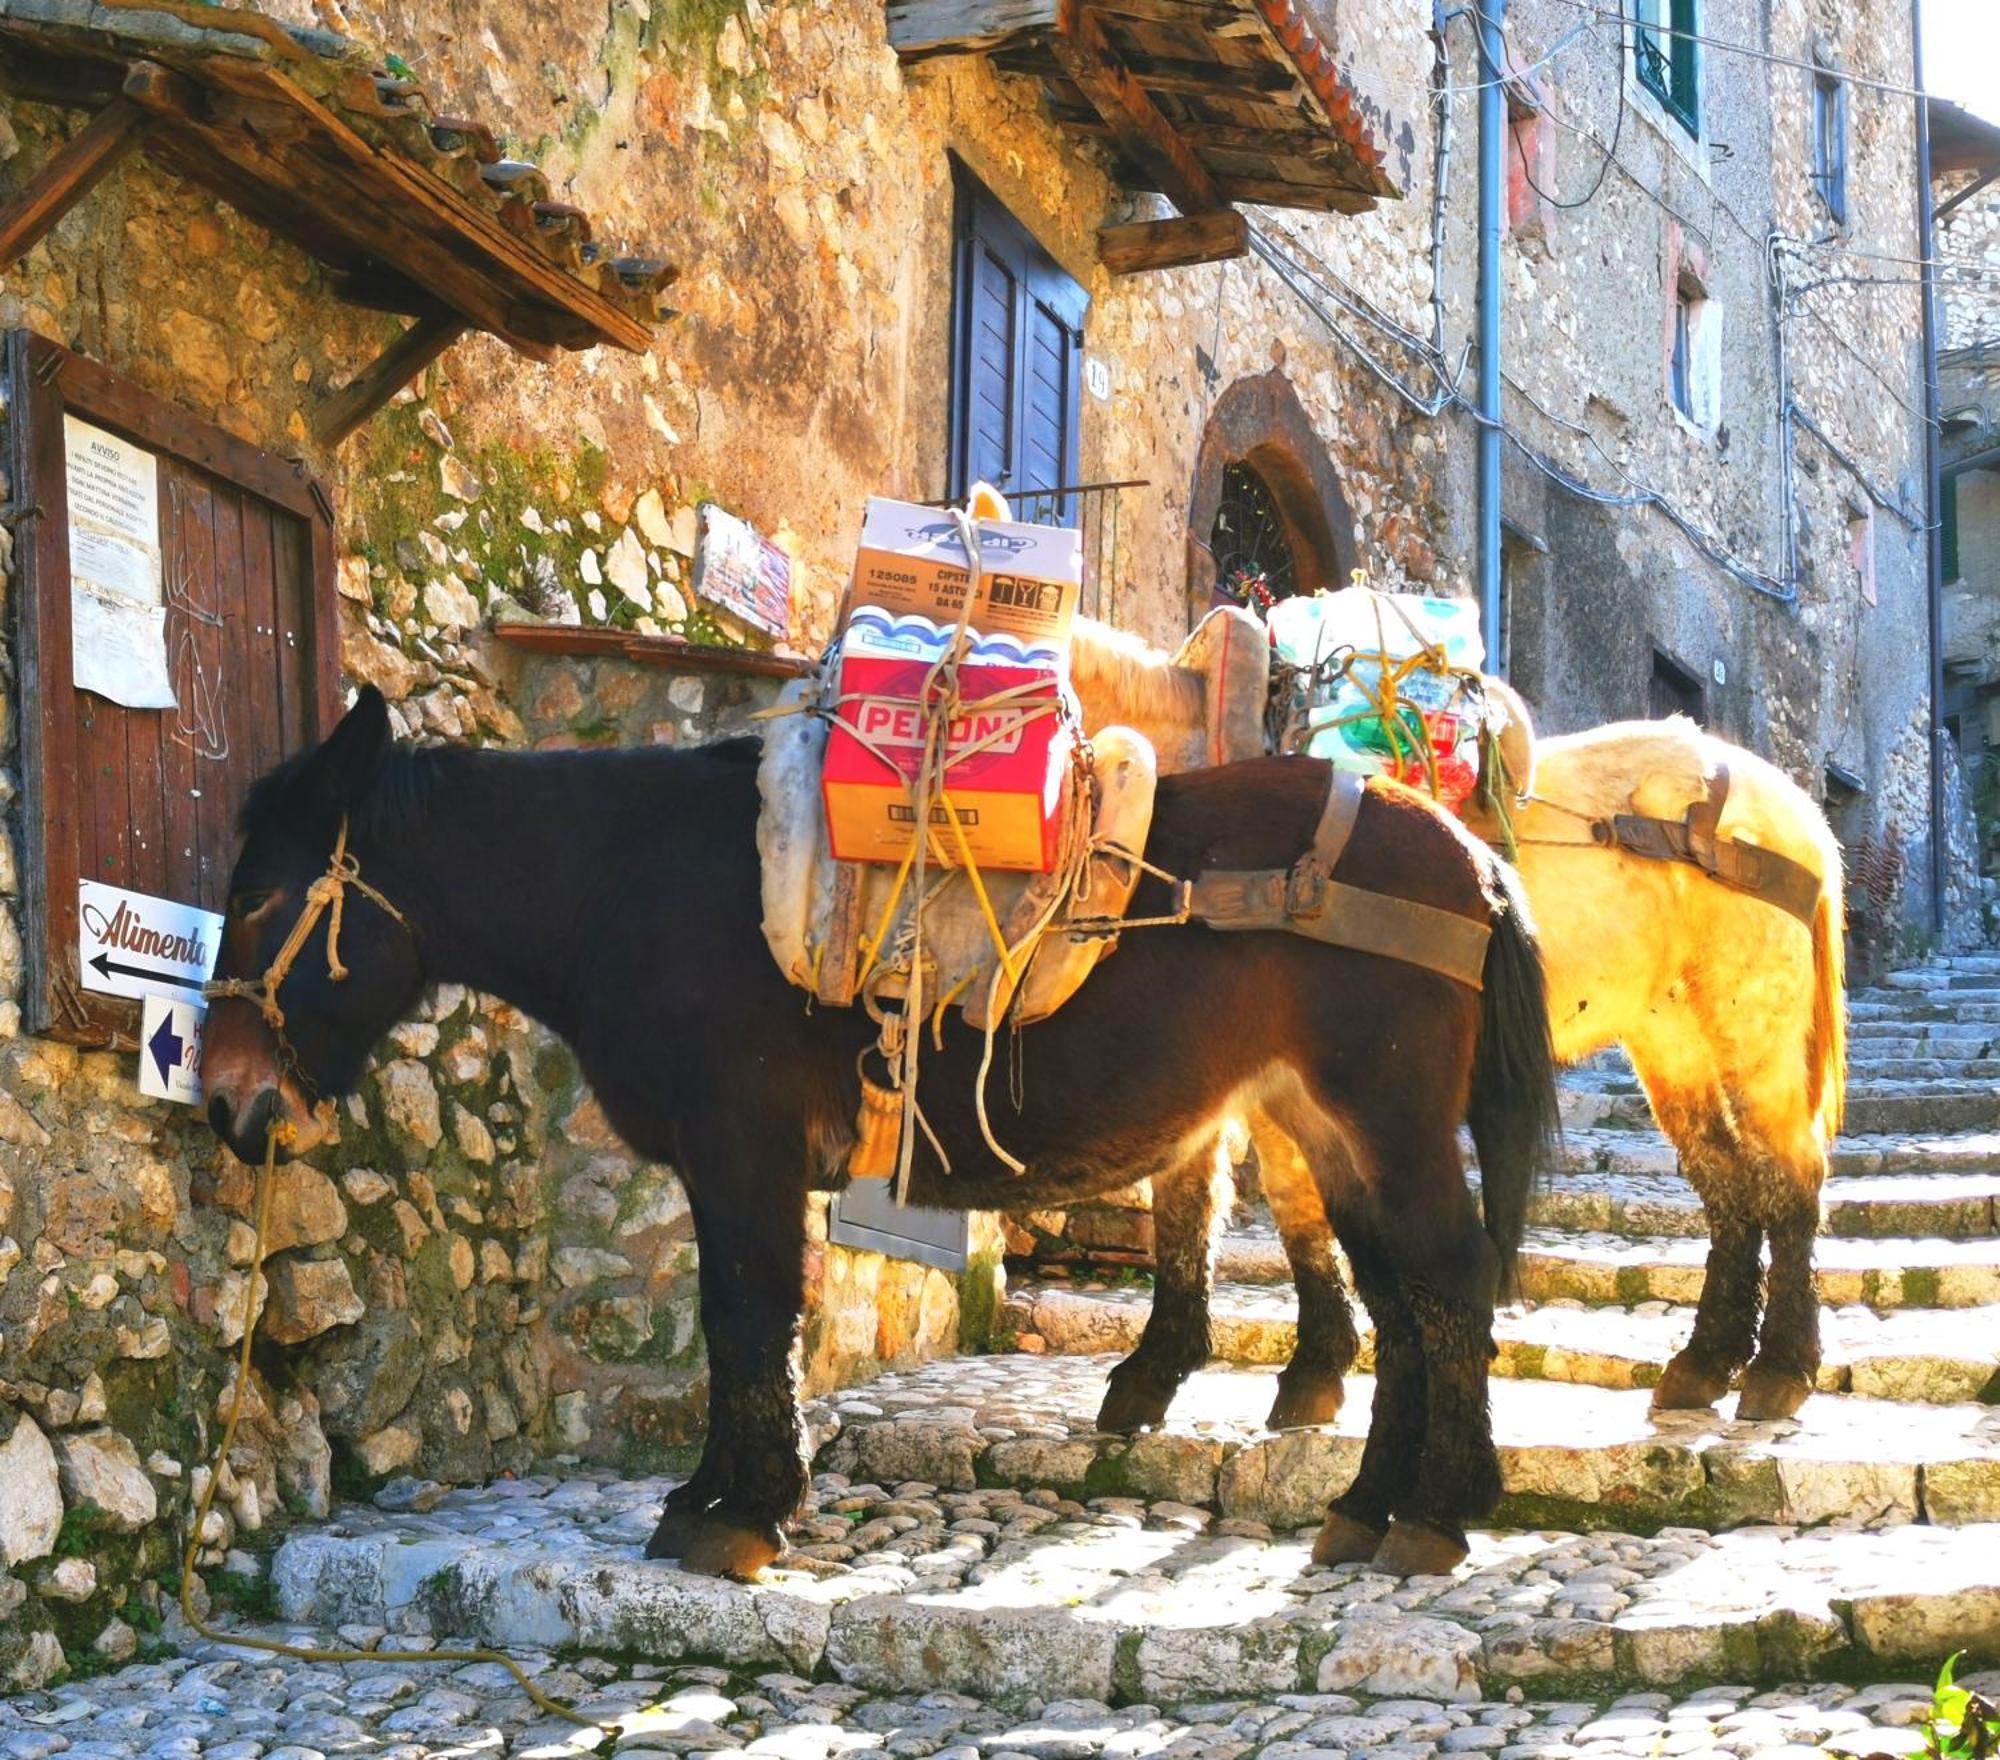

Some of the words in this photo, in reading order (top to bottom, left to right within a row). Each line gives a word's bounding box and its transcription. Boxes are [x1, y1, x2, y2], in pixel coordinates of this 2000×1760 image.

[91, 441, 120, 461] AVVISO
[870, 569, 917, 585] 125085
[937, 570, 970, 585] CIPSTE
